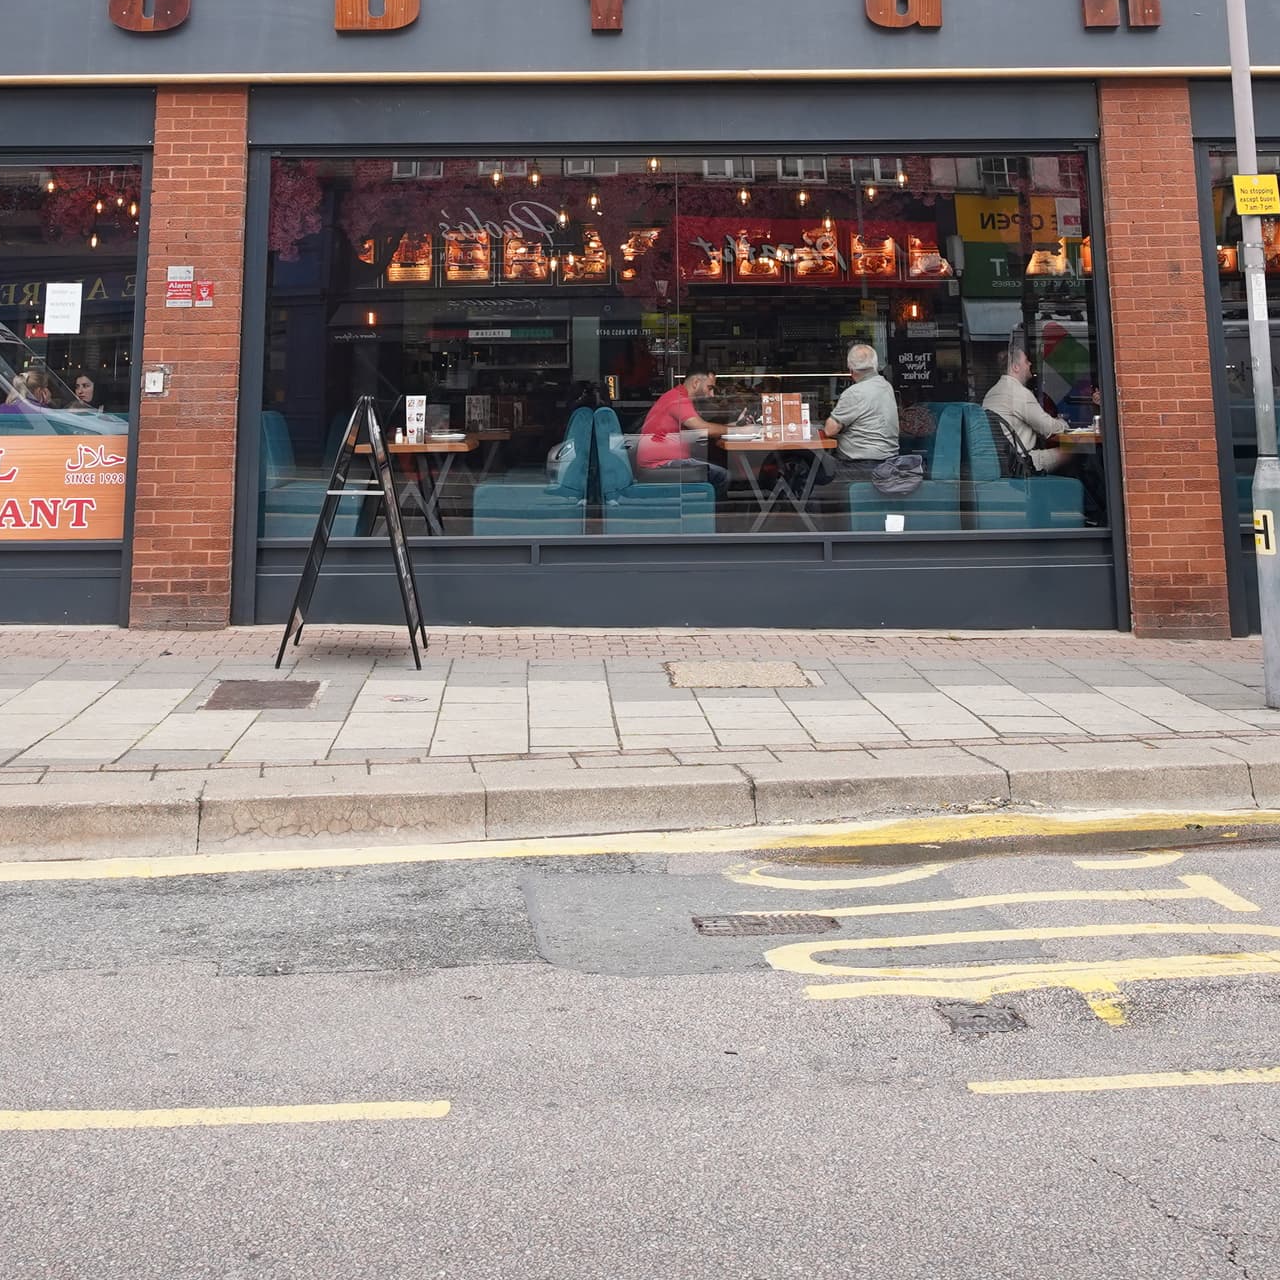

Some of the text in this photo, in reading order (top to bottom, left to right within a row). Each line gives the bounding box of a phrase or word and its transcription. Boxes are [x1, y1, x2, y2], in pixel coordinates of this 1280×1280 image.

[65, 444, 126, 472] حلال
[65, 472, 126, 486] SINCE 1998
